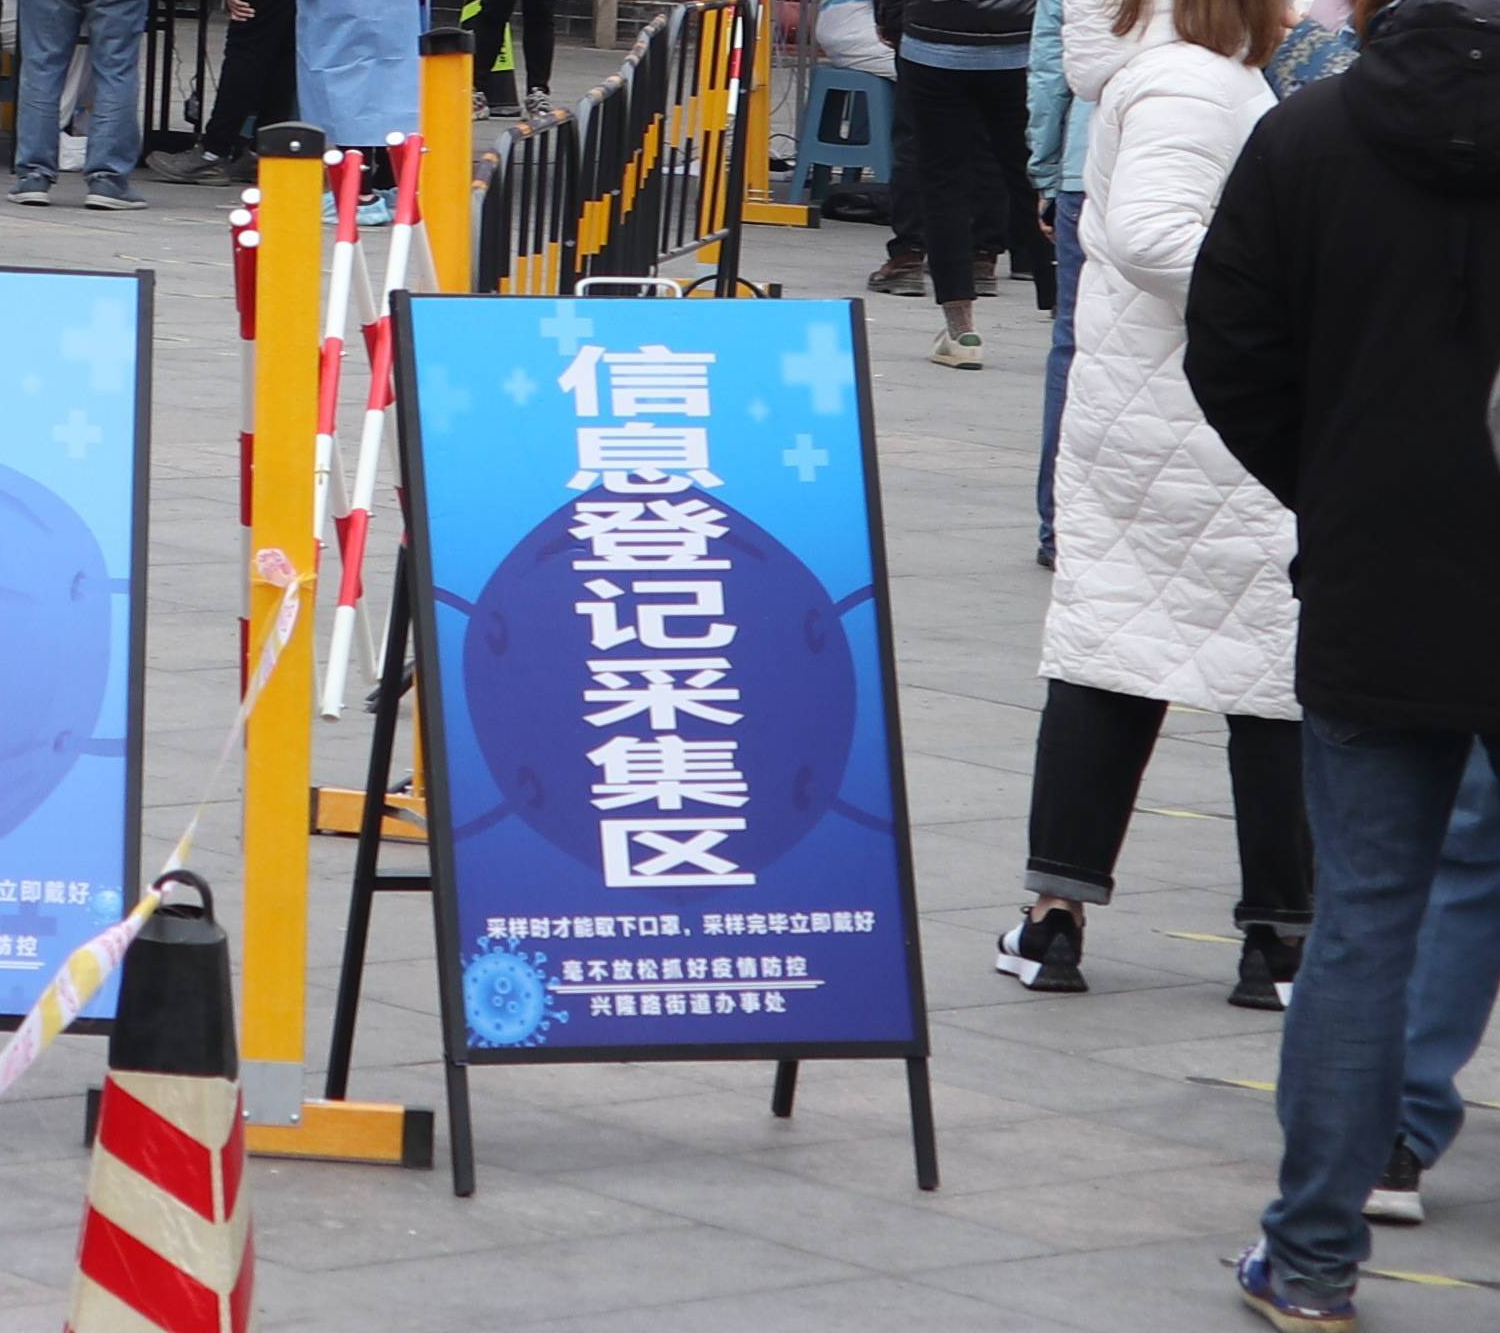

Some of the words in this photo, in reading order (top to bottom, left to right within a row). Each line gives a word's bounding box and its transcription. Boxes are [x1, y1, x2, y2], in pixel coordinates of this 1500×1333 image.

[557, 344, 757, 889] 信息登记采集区
[589, 992, 787, 1017] 兴隆路街道办事处
